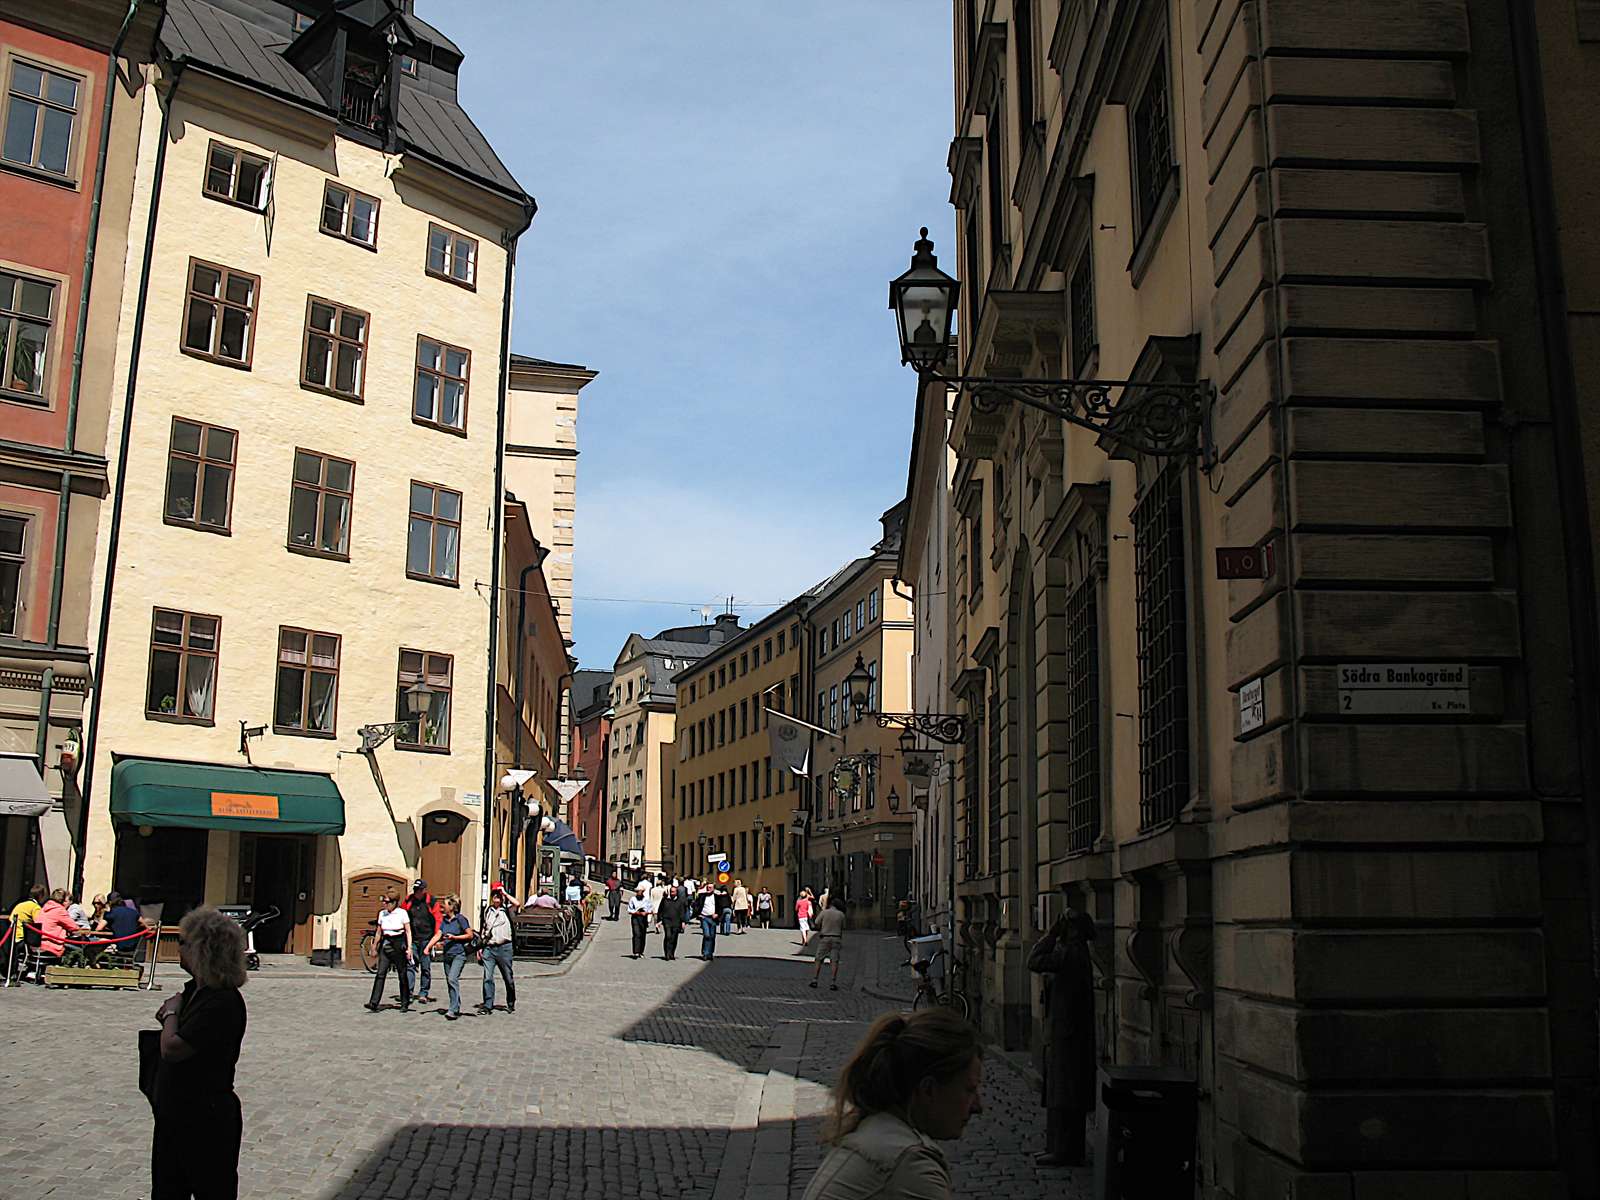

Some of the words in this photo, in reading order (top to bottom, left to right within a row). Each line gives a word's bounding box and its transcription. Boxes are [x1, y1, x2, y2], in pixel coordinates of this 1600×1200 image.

[1342, 667, 1380, 683] Södra
[1386, 667, 1463, 686] Bankogränd
[1343, 695, 1352, 710] 2
